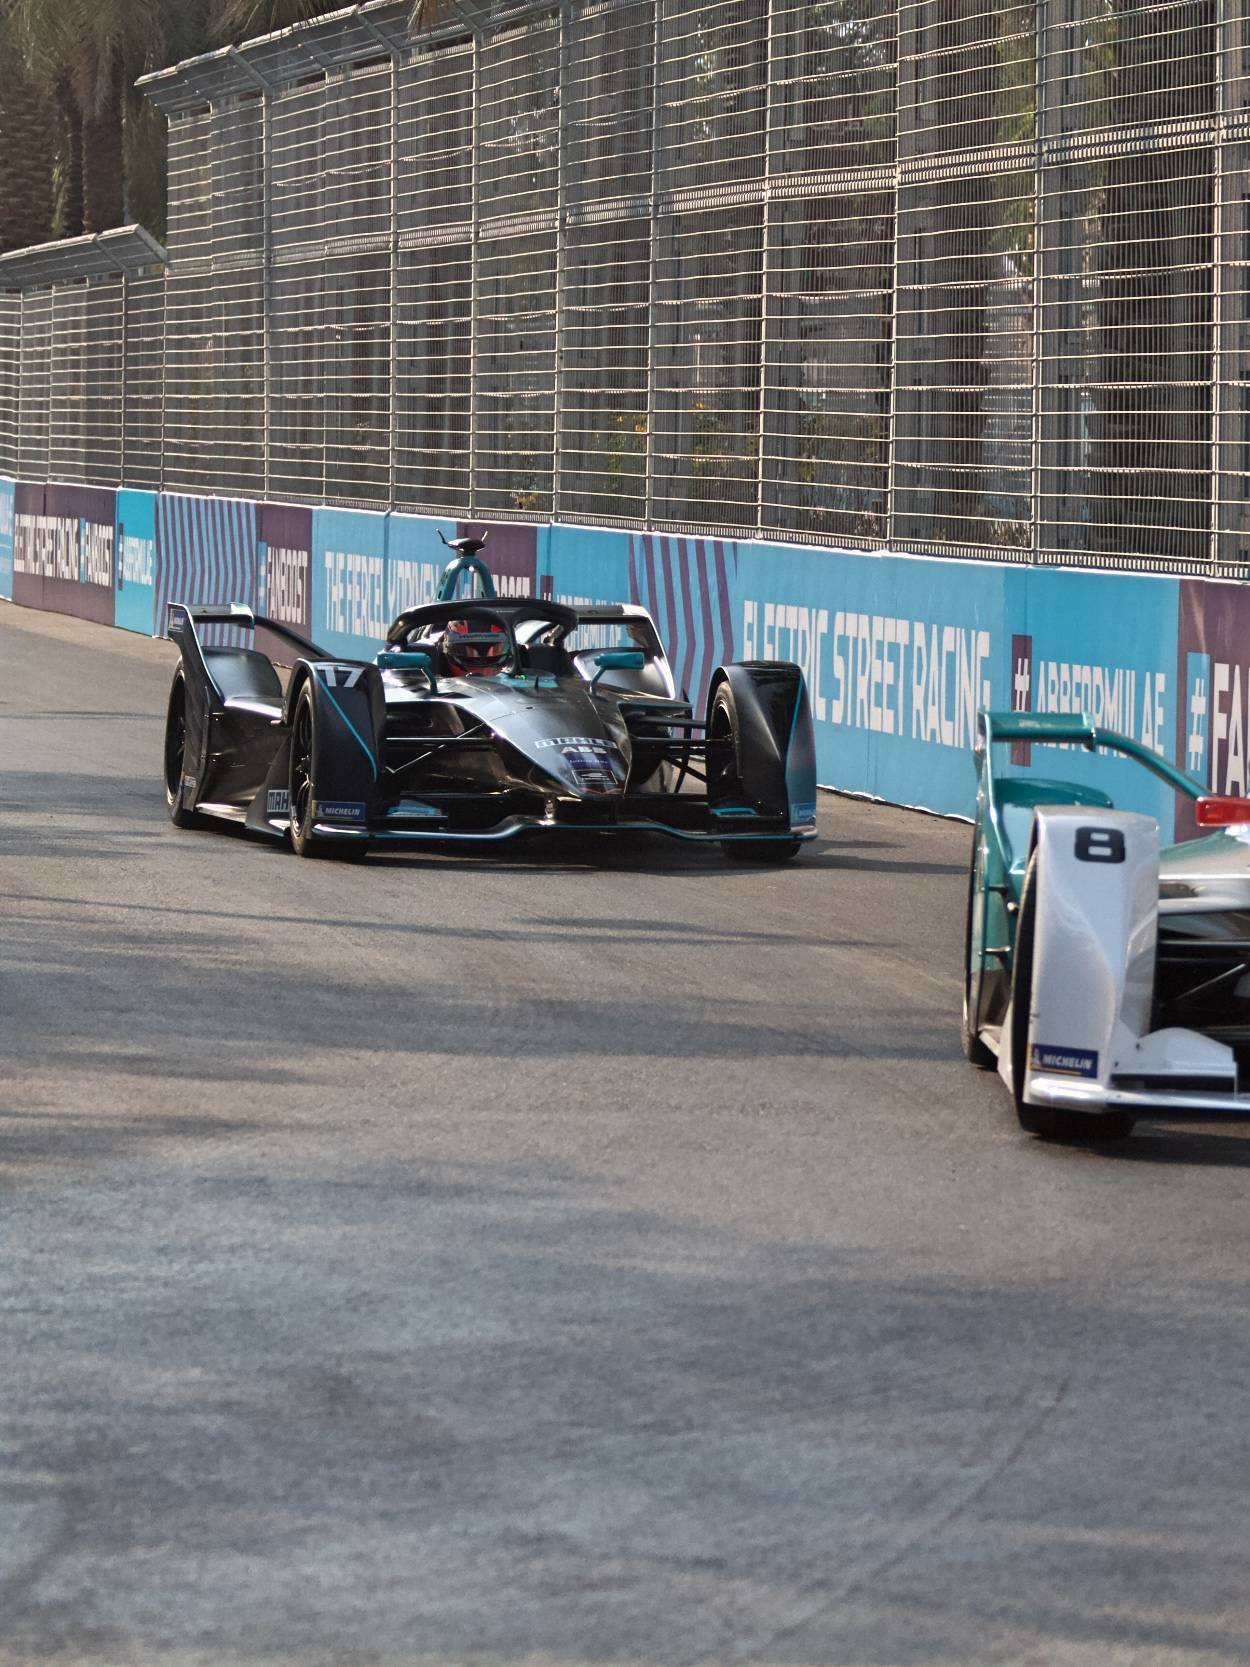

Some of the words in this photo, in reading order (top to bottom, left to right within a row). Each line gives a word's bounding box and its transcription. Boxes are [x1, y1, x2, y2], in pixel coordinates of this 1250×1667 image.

[325, 551, 346, 633] THE
[317, 665, 366, 688] 17
[743, 600, 829, 722] ELECTRIC
[832, 611, 910, 736] STREET
[912, 621, 991, 752] RACING
[267, 790, 289, 812] MAH
[325, 807, 361, 816] MICHELIN
[1074, 826, 1126, 864] 8
[1042, 1053, 1093, 1070] MICHELIN
